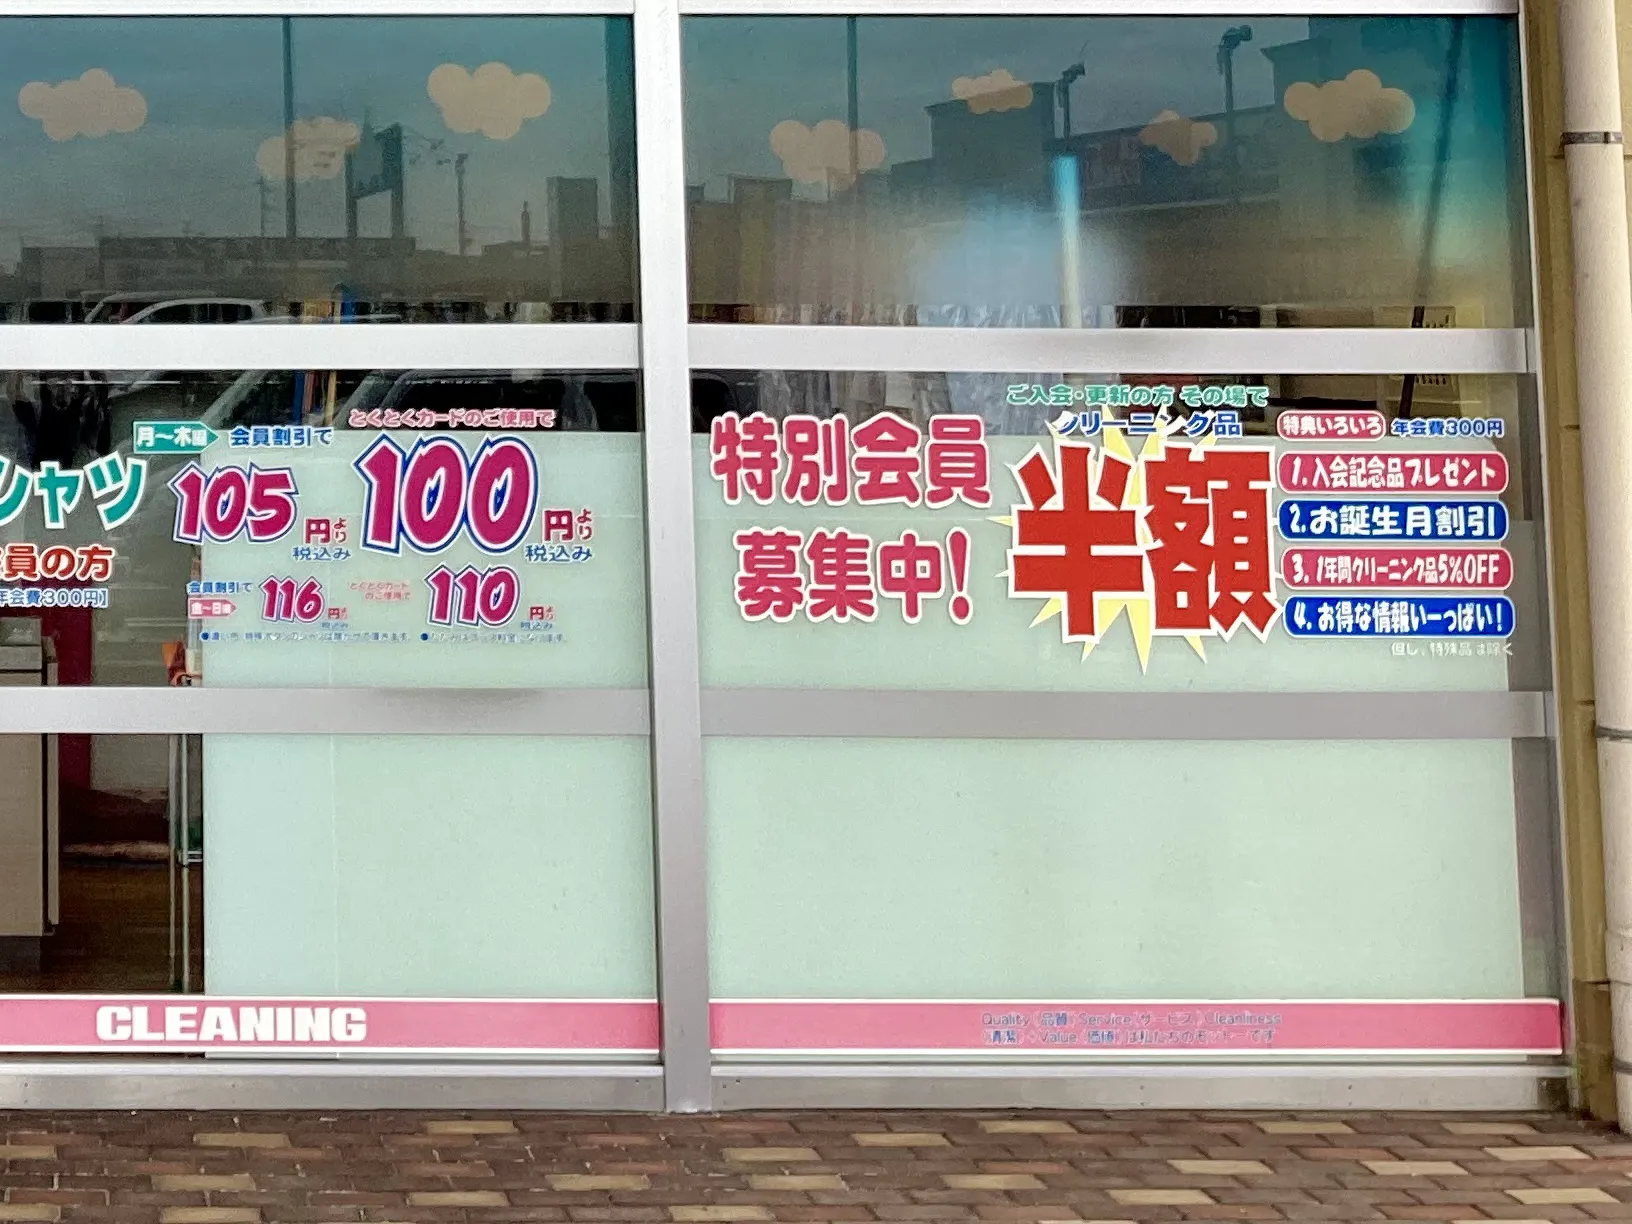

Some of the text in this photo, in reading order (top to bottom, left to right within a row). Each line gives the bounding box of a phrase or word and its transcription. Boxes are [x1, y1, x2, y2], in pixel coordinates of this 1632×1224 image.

[1007, 384, 1268, 407] ご入会・更新の方 その場で
[348, 408, 556, 429] とくとくカードのご使用で
[1056, 409, 1244, 439] クリーニング品
[1282, 413, 1382, 438] 特典いろいろ
[1391, 418, 1506, 439] 年会費300円
[229, 426, 334, 448] 会員割引で
[710, 411, 992, 509] 特別会員
[1290, 456, 1498, 488] 1.入会記念品プレゼント
[169, 460, 300, 546] 105
[352, 432, 540, 557] 100
[1288, 505, 1497, 536] 2.お誕生月割引
[293, 546, 352, 561] 税込み
[525, 545, 594, 562] 税込み
[1008, 437, 1282, 644] 半額
[187, 582, 253, 594] 会員割引で
[733, 526, 973, 625] 募集中!
[258, 575, 325, 624] 116
[424, 564, 521, 627] 110
[95, 1005, 367, 1043] CLEANING
